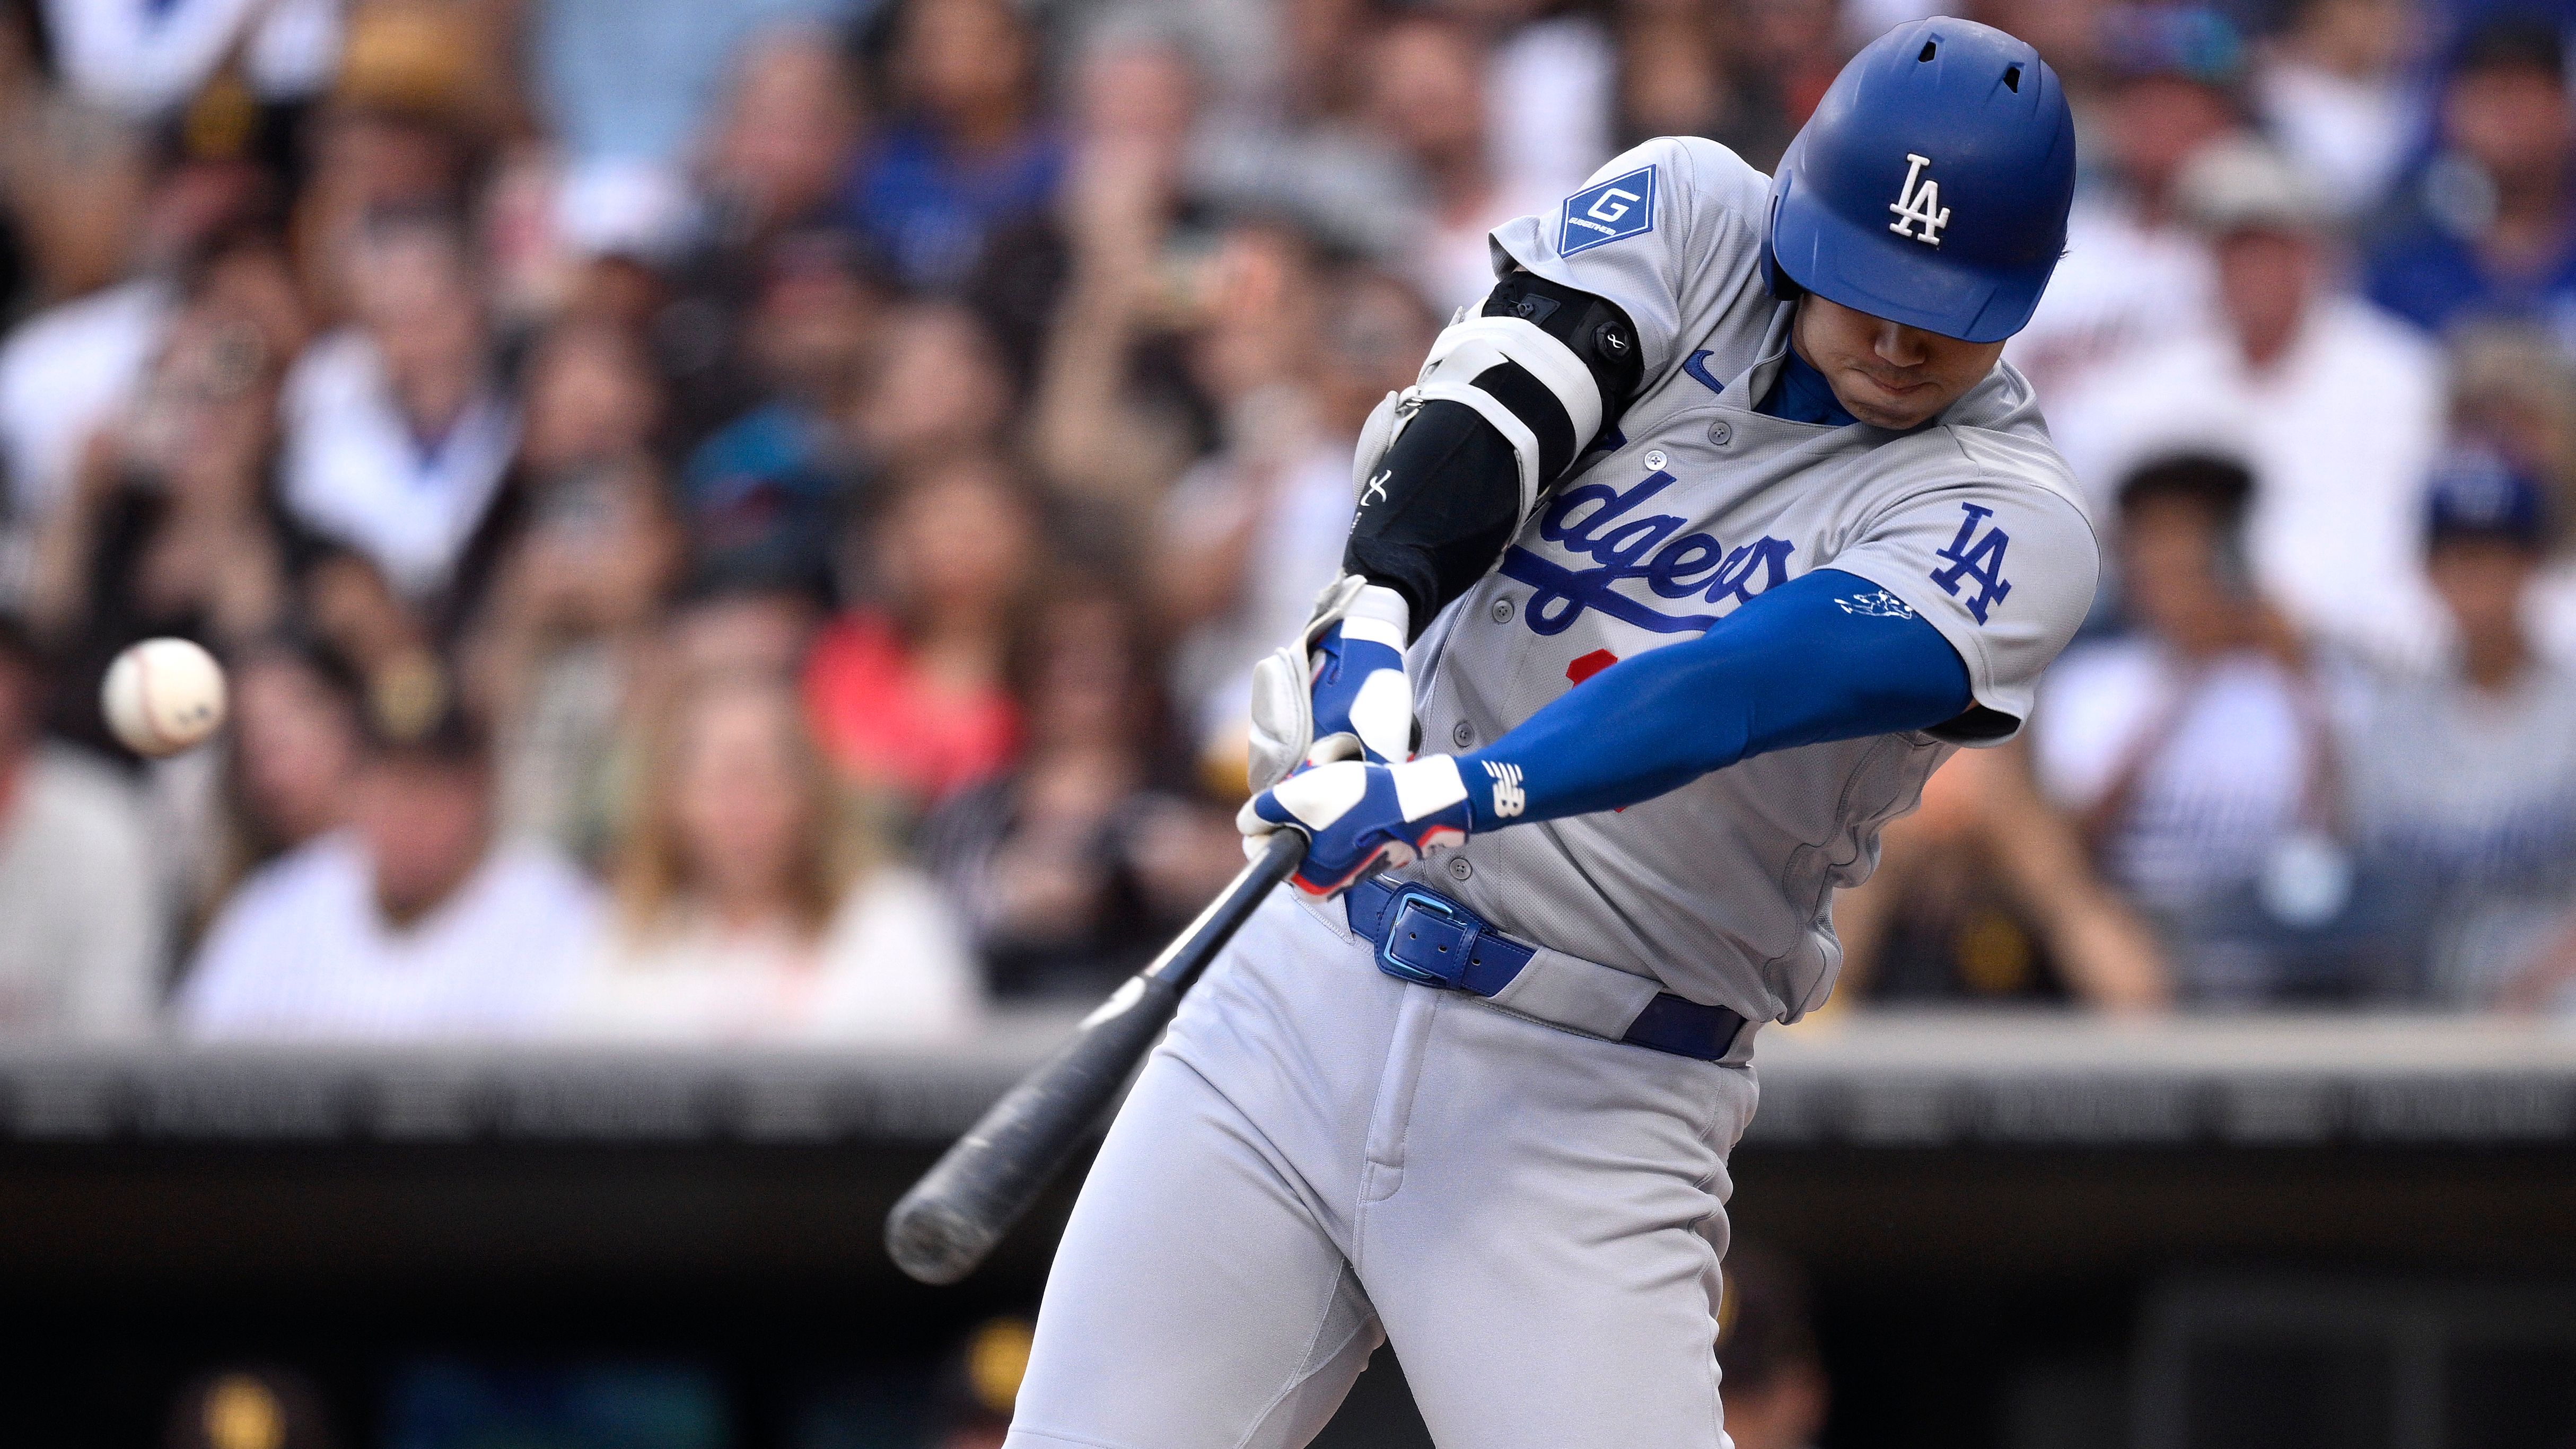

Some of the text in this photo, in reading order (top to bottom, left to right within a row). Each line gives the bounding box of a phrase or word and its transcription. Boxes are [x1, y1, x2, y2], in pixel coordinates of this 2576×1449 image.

[1587, 188, 1641, 222] G
[1889, 153, 1951, 245] LA
[1498, 471, 1795, 635] dgers
[1929, 501, 2012, 627] LA
